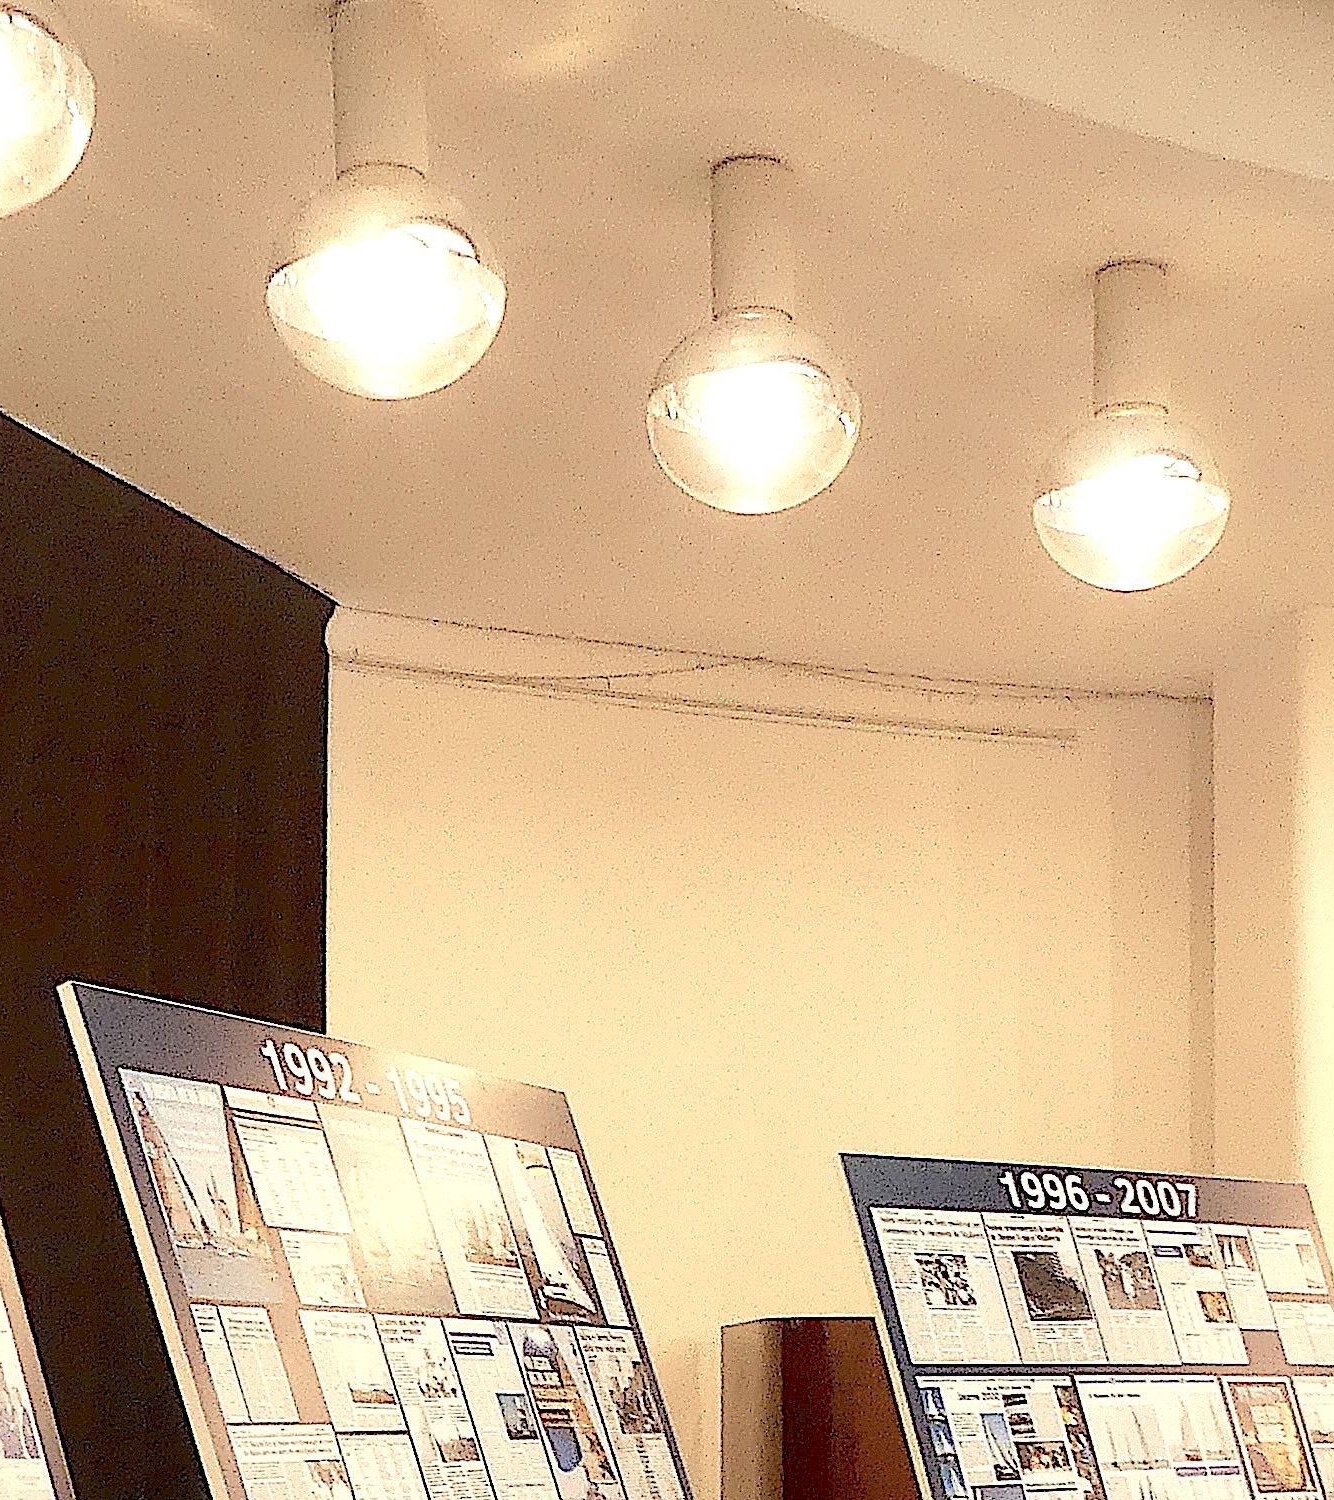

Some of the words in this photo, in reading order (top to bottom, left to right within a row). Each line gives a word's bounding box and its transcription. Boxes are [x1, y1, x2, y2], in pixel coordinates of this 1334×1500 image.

[260, 1038, 363, 1104] 1992
[385, 1064, 473, 1127] 1995
[999, 1170, 1091, 1212] 1996
[1111, 1177, 1199, 1218] 2007
